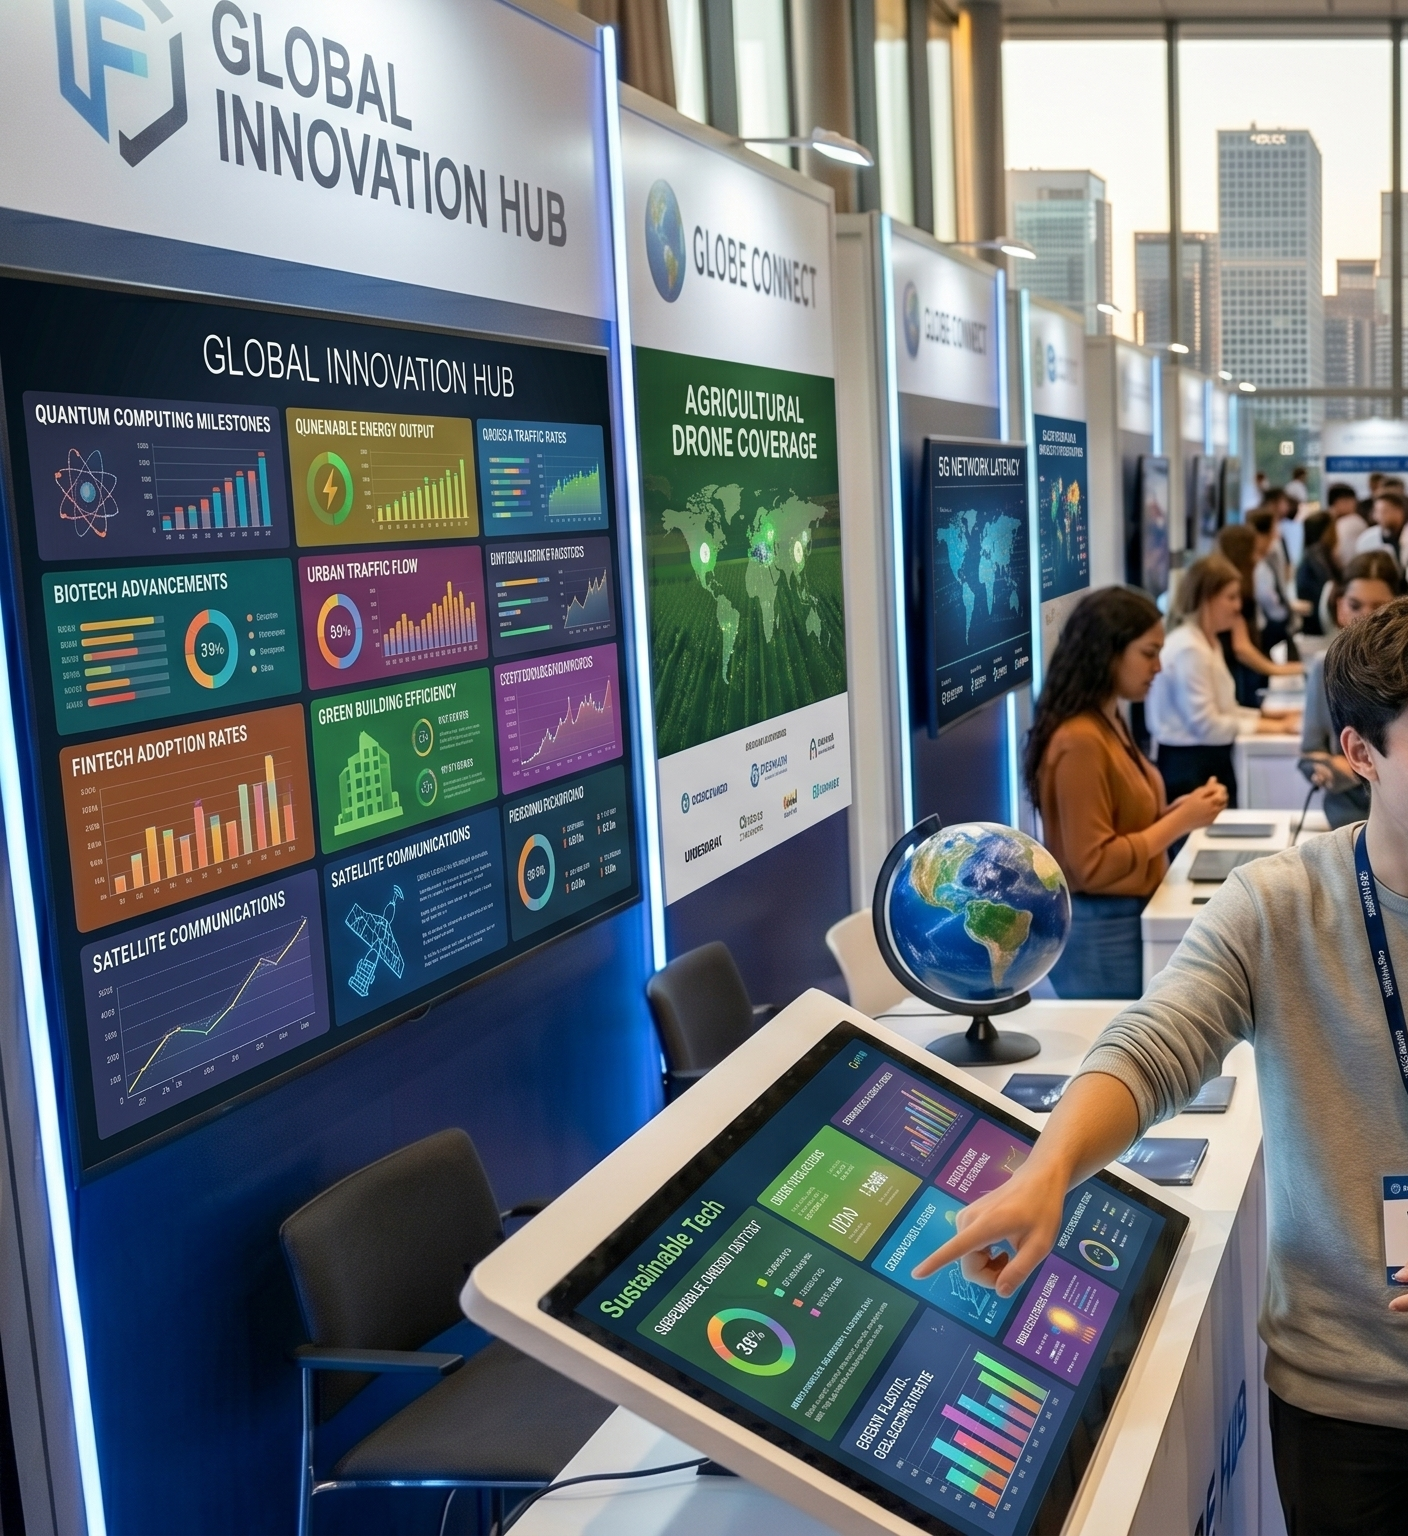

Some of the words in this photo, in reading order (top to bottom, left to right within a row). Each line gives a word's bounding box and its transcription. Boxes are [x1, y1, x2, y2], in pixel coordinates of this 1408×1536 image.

[211, 0, 413, 132] GLOBAL
[216, 89, 488, 229] INNOVATION
[500, 175, 567, 248] HUB
[693, 225, 747, 288] GLOBE
[752, 247, 817, 308] CONNECT
[203, 334, 320, 384] GLOBAL
[326, 347, 467, 396] INNOVATION
[473, 367, 515, 398] HUB
[35, 404, 110, 425] QUANTUM
[113, 408, 194, 429] COMPUTING
[197, 413, 271, 433] MILESTONES
[685, 384, 804, 424] AGRICULTURAL
[360, 421, 397, 437] ENERGY
[399, 423, 434, 439] OUTPUT
[672, 424, 734, 457] DRONE
[737, 429, 818, 459] COVERAGE
[938, 456, 950, 477] 5G
[951, 457, 990, 477] NETWORK
[990, 458, 1021, 477] LATENCY
[53, 581, 118, 604] BIOTECH
[121, 572, 228, 598] ADVANCEMENTS
[307, 563, 345, 582] URBAN
[347, 560, 390, 579] TRAFFIC
[392, 558, 418, 574] FLOW
[201, 642, 225, 658] 39%
[318, 705, 353, 725] GREEN
[355, 694, 403, 718] BUILDING
[405, 683, 457, 708] EFFICIENCY
[71, 748, 134, 777] FINTECH
[137, 733, 206, 764] ADOPTION
[208, 724, 248, 748] RATES
[331, 854, 385, 888] SATELLITE
[386, 825, 471, 869] COMMUNICATIONS
[92, 931, 167, 974] SATELLITE
[169, 890, 286, 946] COMMUNICATIONS
[600, 1233, 694, 1318] Sustainable
[681, 1200, 726, 1233] Tech
[736, 1330, 765, 1356] 38%
